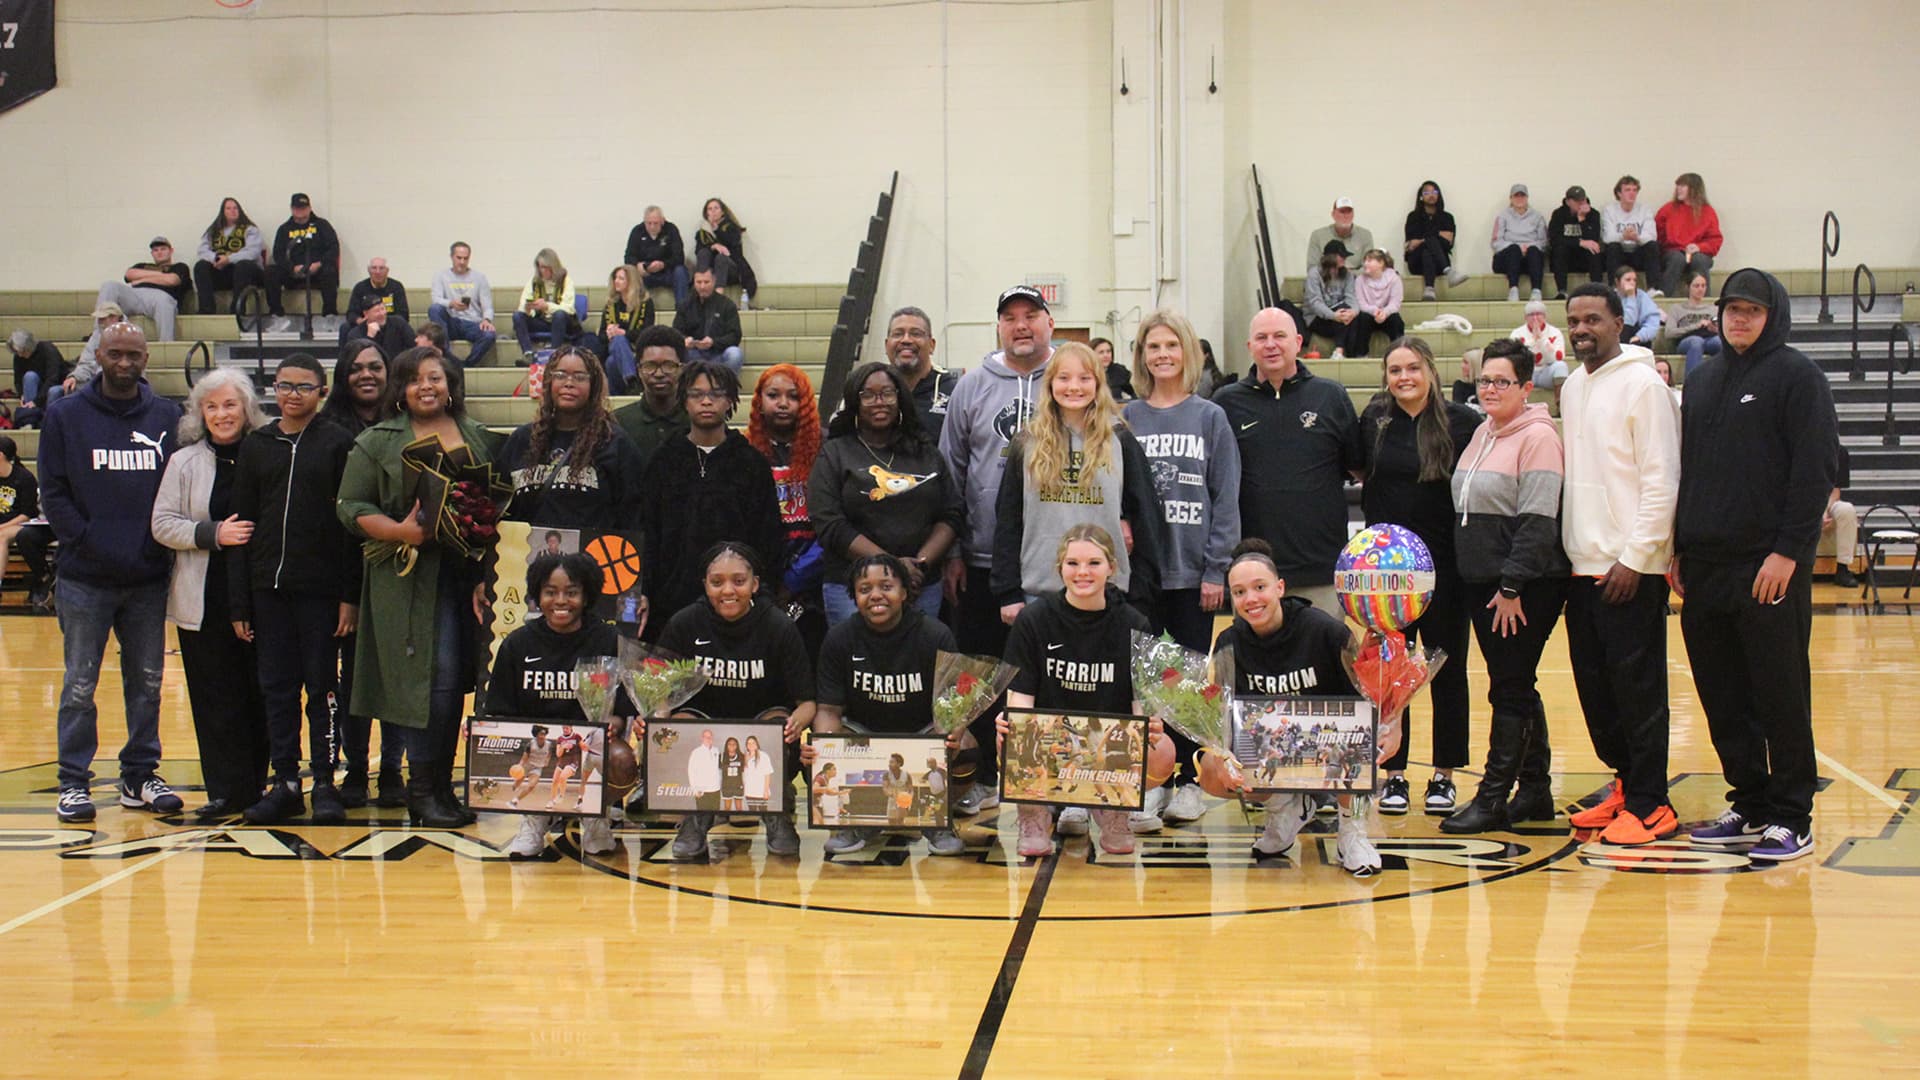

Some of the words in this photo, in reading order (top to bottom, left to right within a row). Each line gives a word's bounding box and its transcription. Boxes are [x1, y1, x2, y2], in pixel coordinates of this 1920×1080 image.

[0, 22, 18, 49] 7
[92, 448, 157, 471] PUMA
[694, 655, 765, 680] FERRUM
[1046, 657, 1115, 683] FERRUM
[853, 670, 923, 694] FERRUM
[1061, 680, 1097, 692] PANTHERS
[868, 692, 906, 703] PANTHERS
[477, 737, 522, 750] THOMAS
